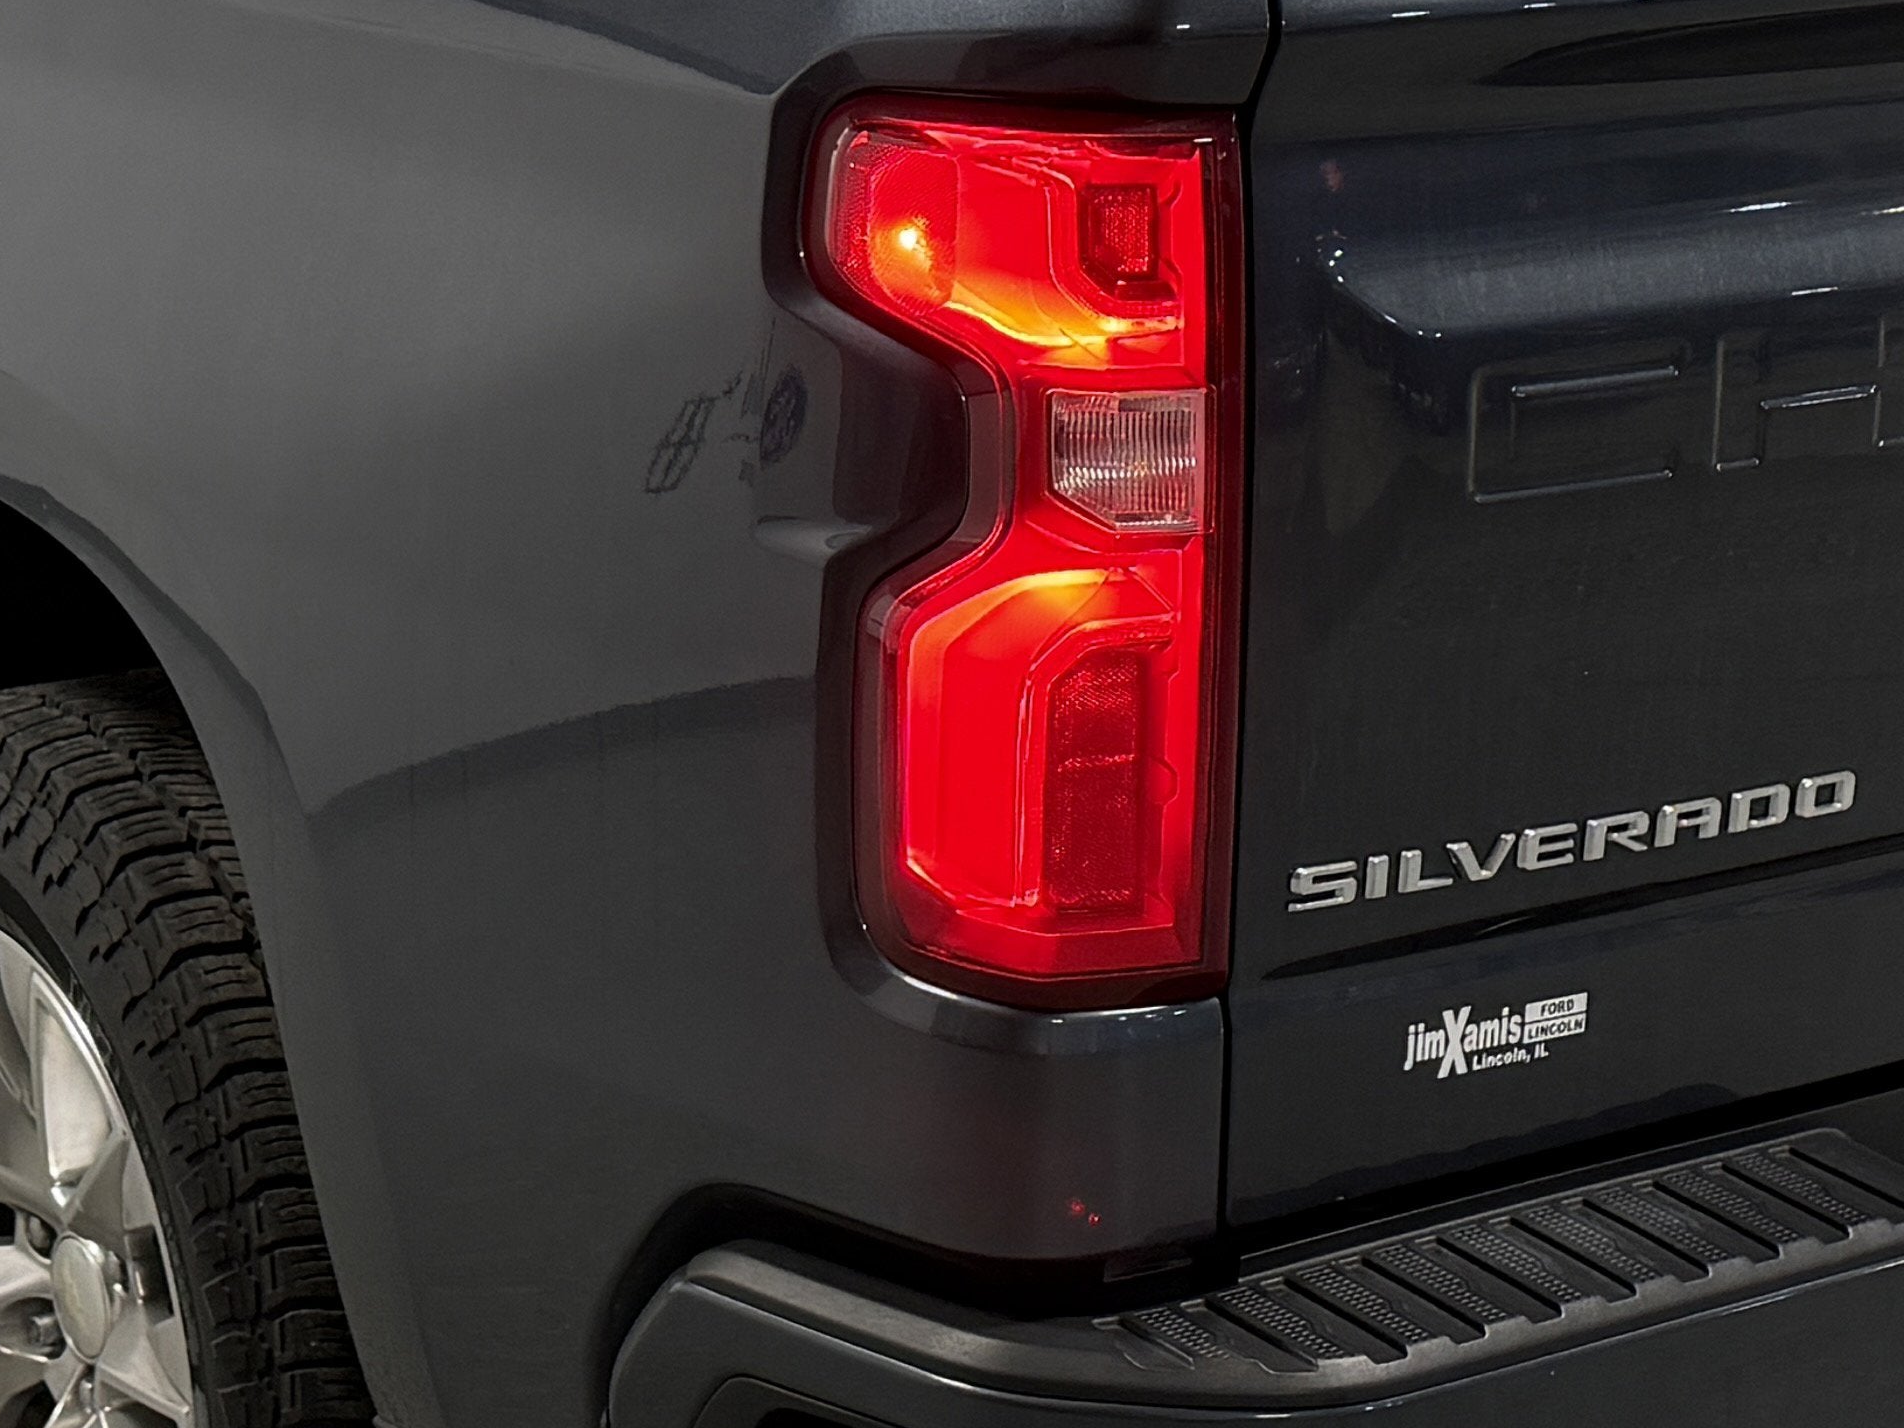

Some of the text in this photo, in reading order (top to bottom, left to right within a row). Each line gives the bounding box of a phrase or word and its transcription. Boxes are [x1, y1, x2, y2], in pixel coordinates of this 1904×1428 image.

[1287, 770, 1856, 912] SILVERADO
[1540, 998, 1575, 1017] FORD
[1527, 1018, 1584, 1040] LINCOLN
[1472, 1042, 1549, 1071] Lincoln, IL
